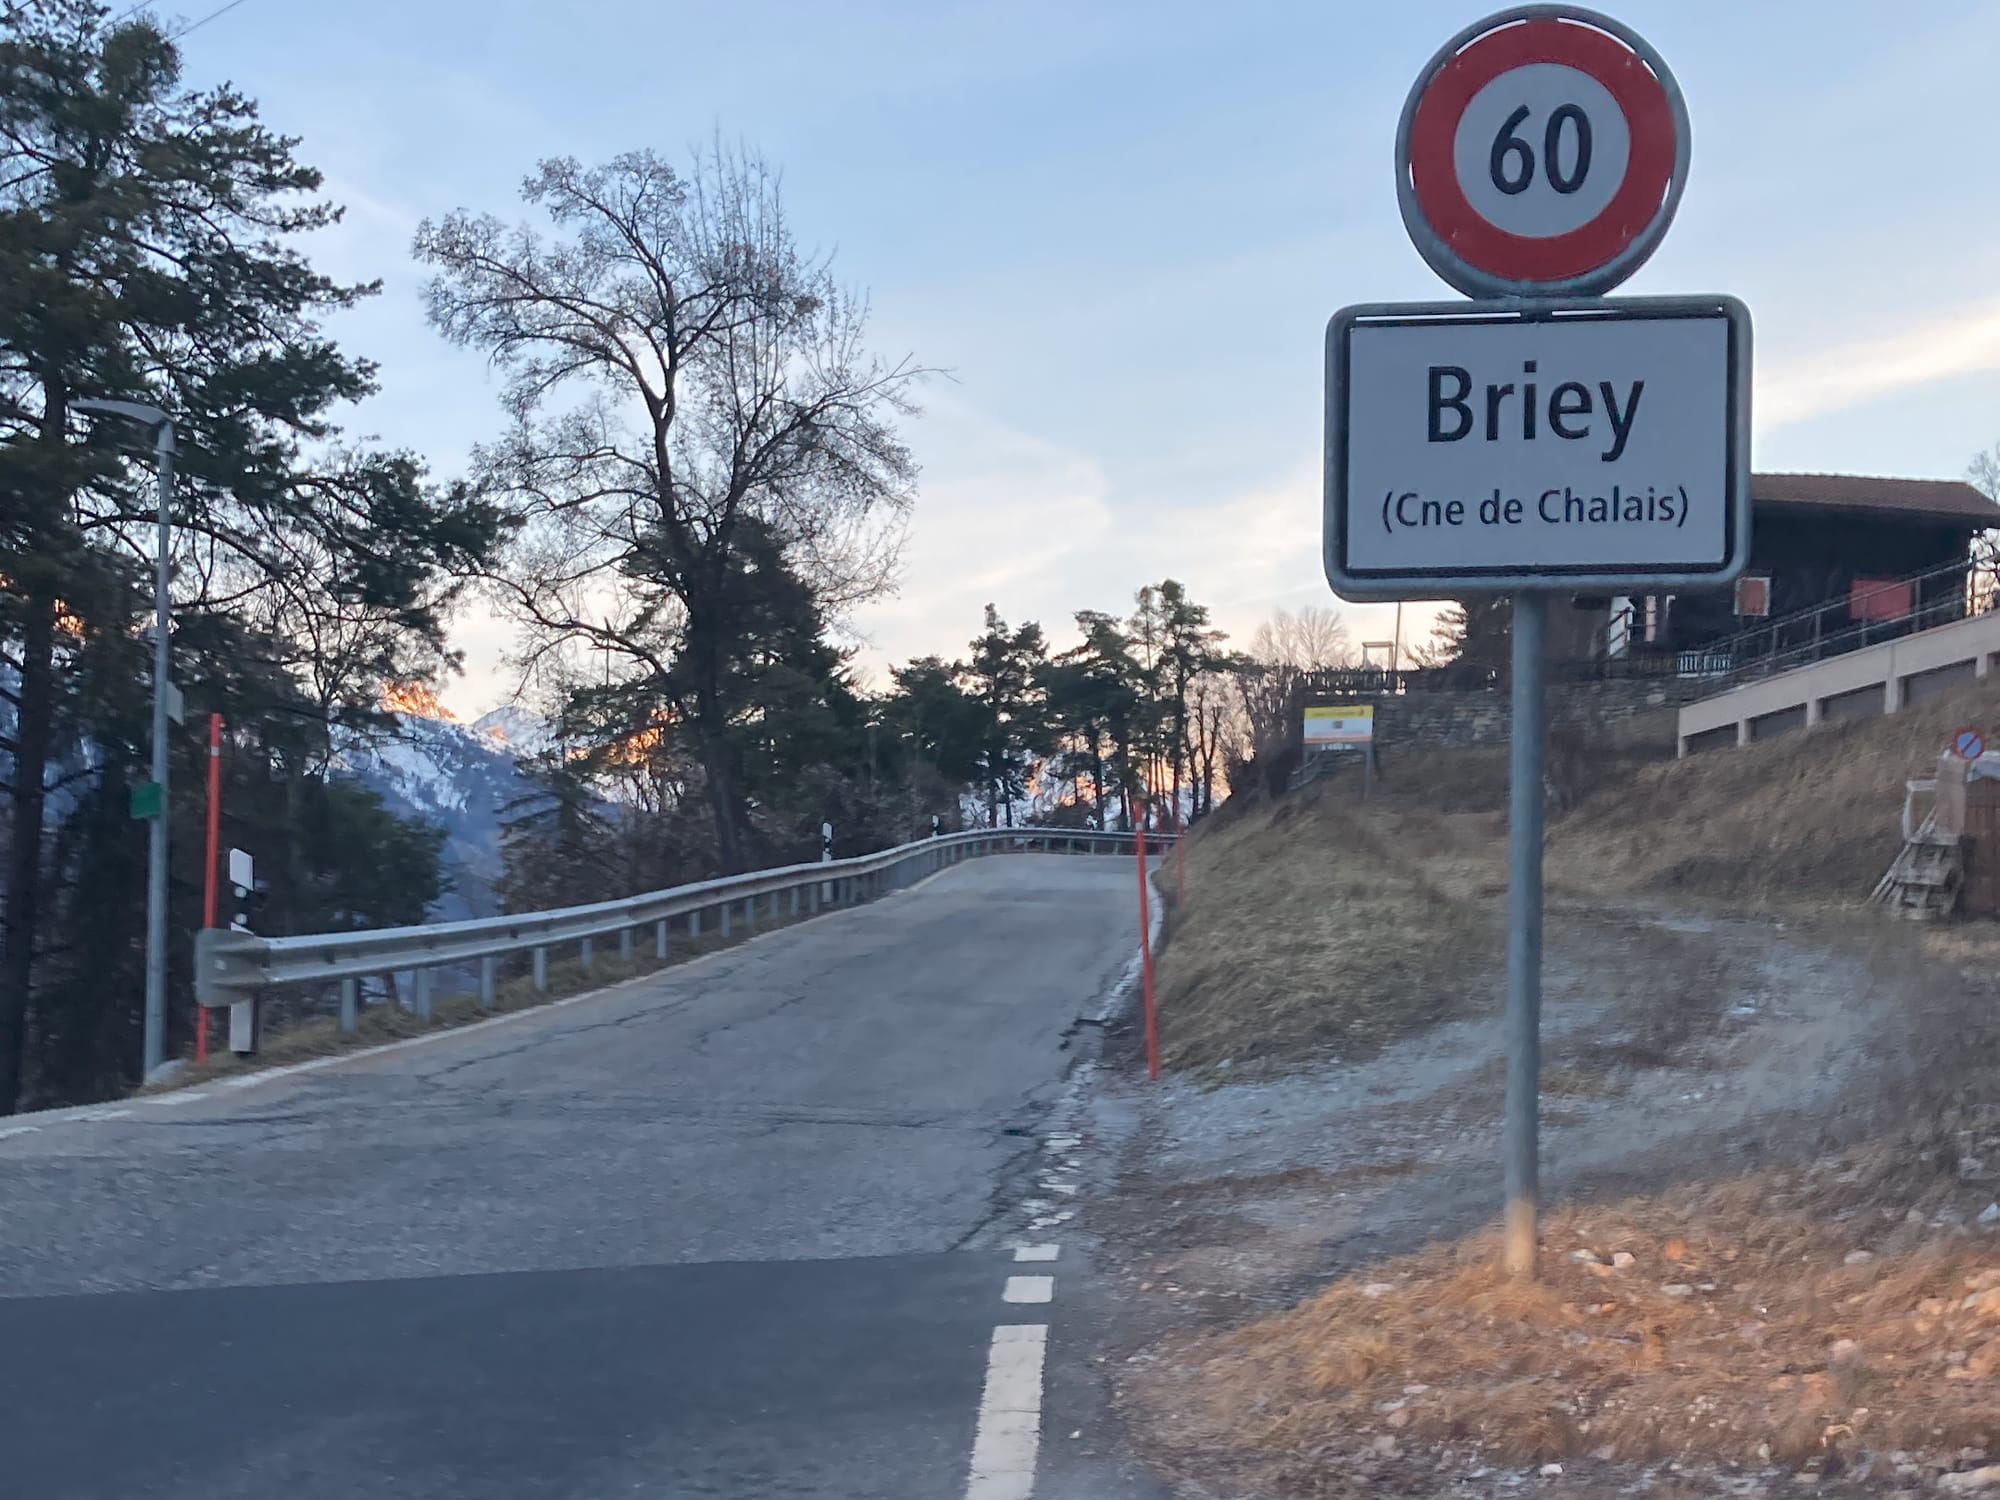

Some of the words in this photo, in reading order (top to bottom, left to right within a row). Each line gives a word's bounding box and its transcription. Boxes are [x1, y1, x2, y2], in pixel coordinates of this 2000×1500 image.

[1489, 102, 1593, 195] 60
[1427, 360, 1645, 462] Briey
[1381, 490, 1465, 533] (Cne
[1479, 488, 1524, 525] de
[1538, 486, 1689, 528] Chalais)
